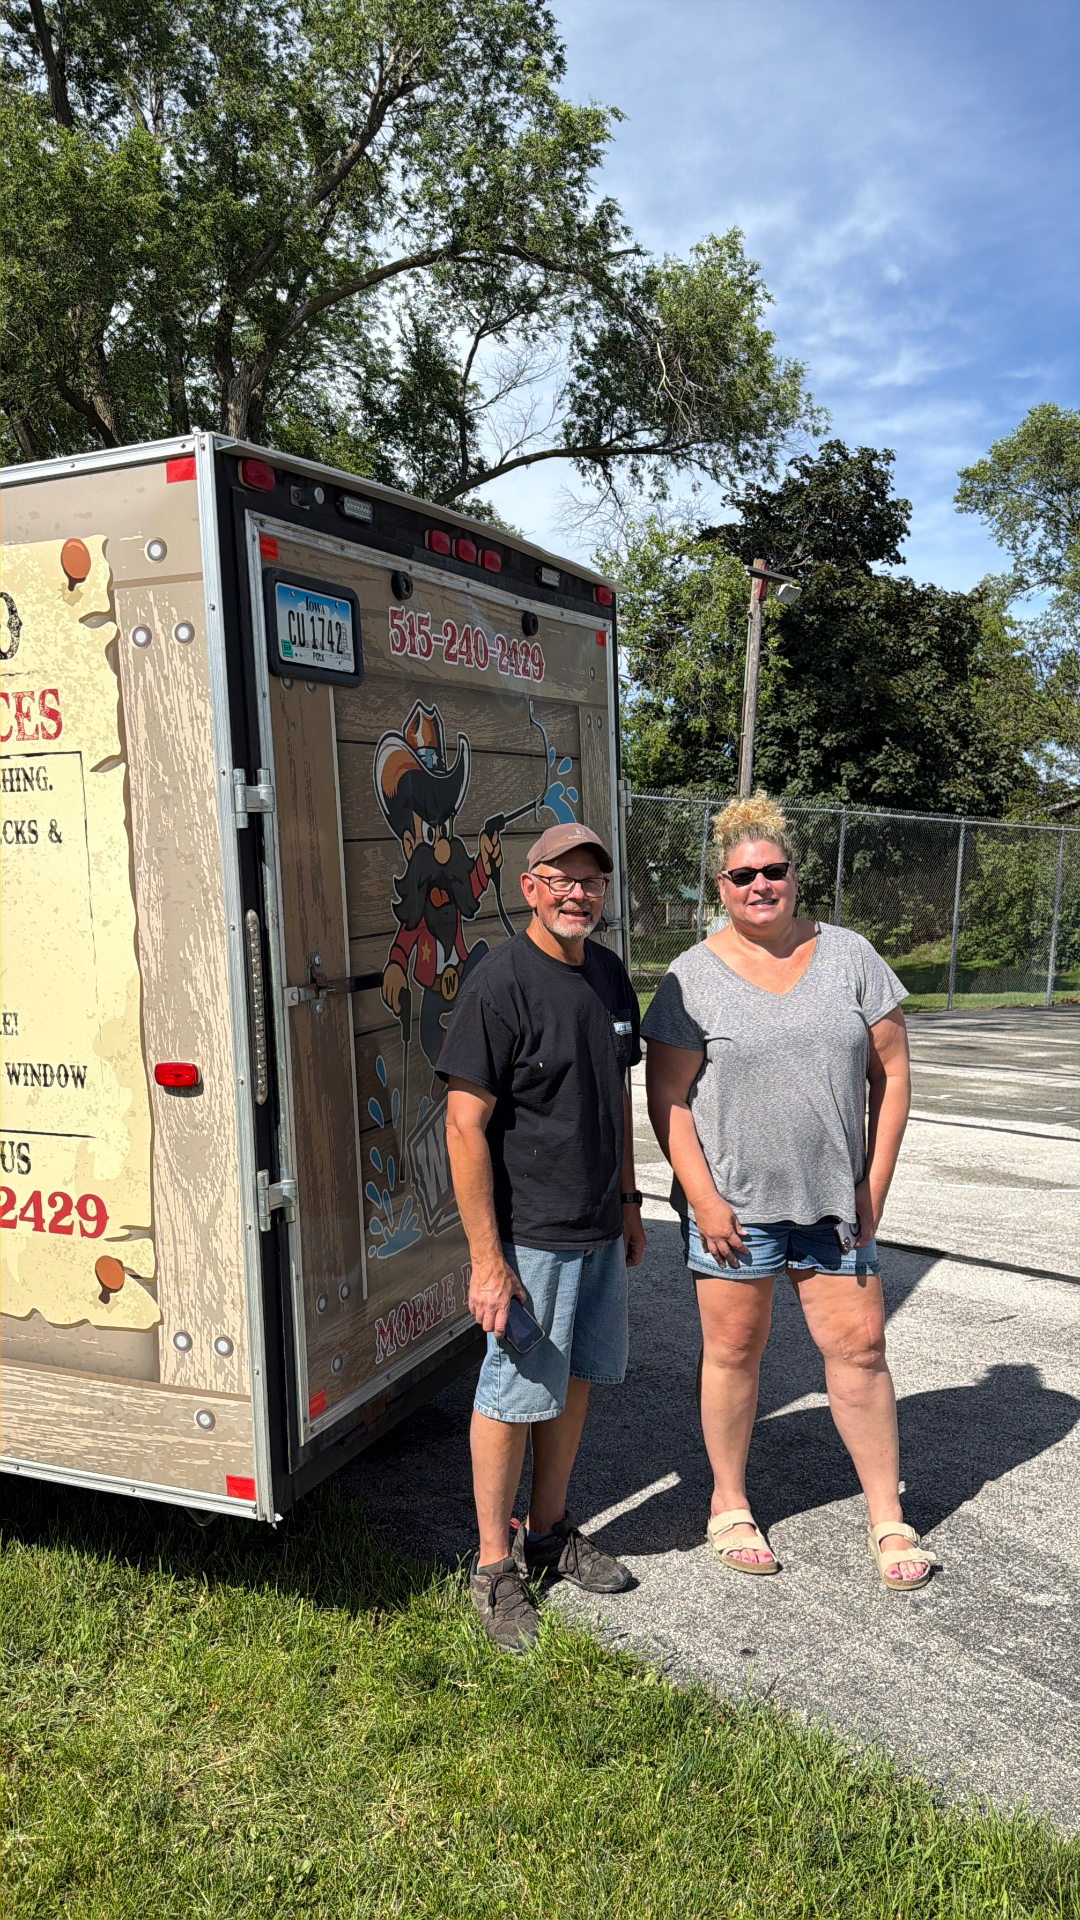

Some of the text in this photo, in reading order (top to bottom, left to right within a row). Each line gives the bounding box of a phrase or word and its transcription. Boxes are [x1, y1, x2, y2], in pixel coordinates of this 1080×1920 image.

[288, 609, 344, 655] CU 1742
[389, 600, 546, 684] 515-240-2429
[48, 818, 63, 844] &
[444, 973, 457, 996] W
[4, 1062, 88, 1090] WINDOW
[0, 1185, 110, 1239] 2429
[375, 1272, 456, 1364] MOBILE
